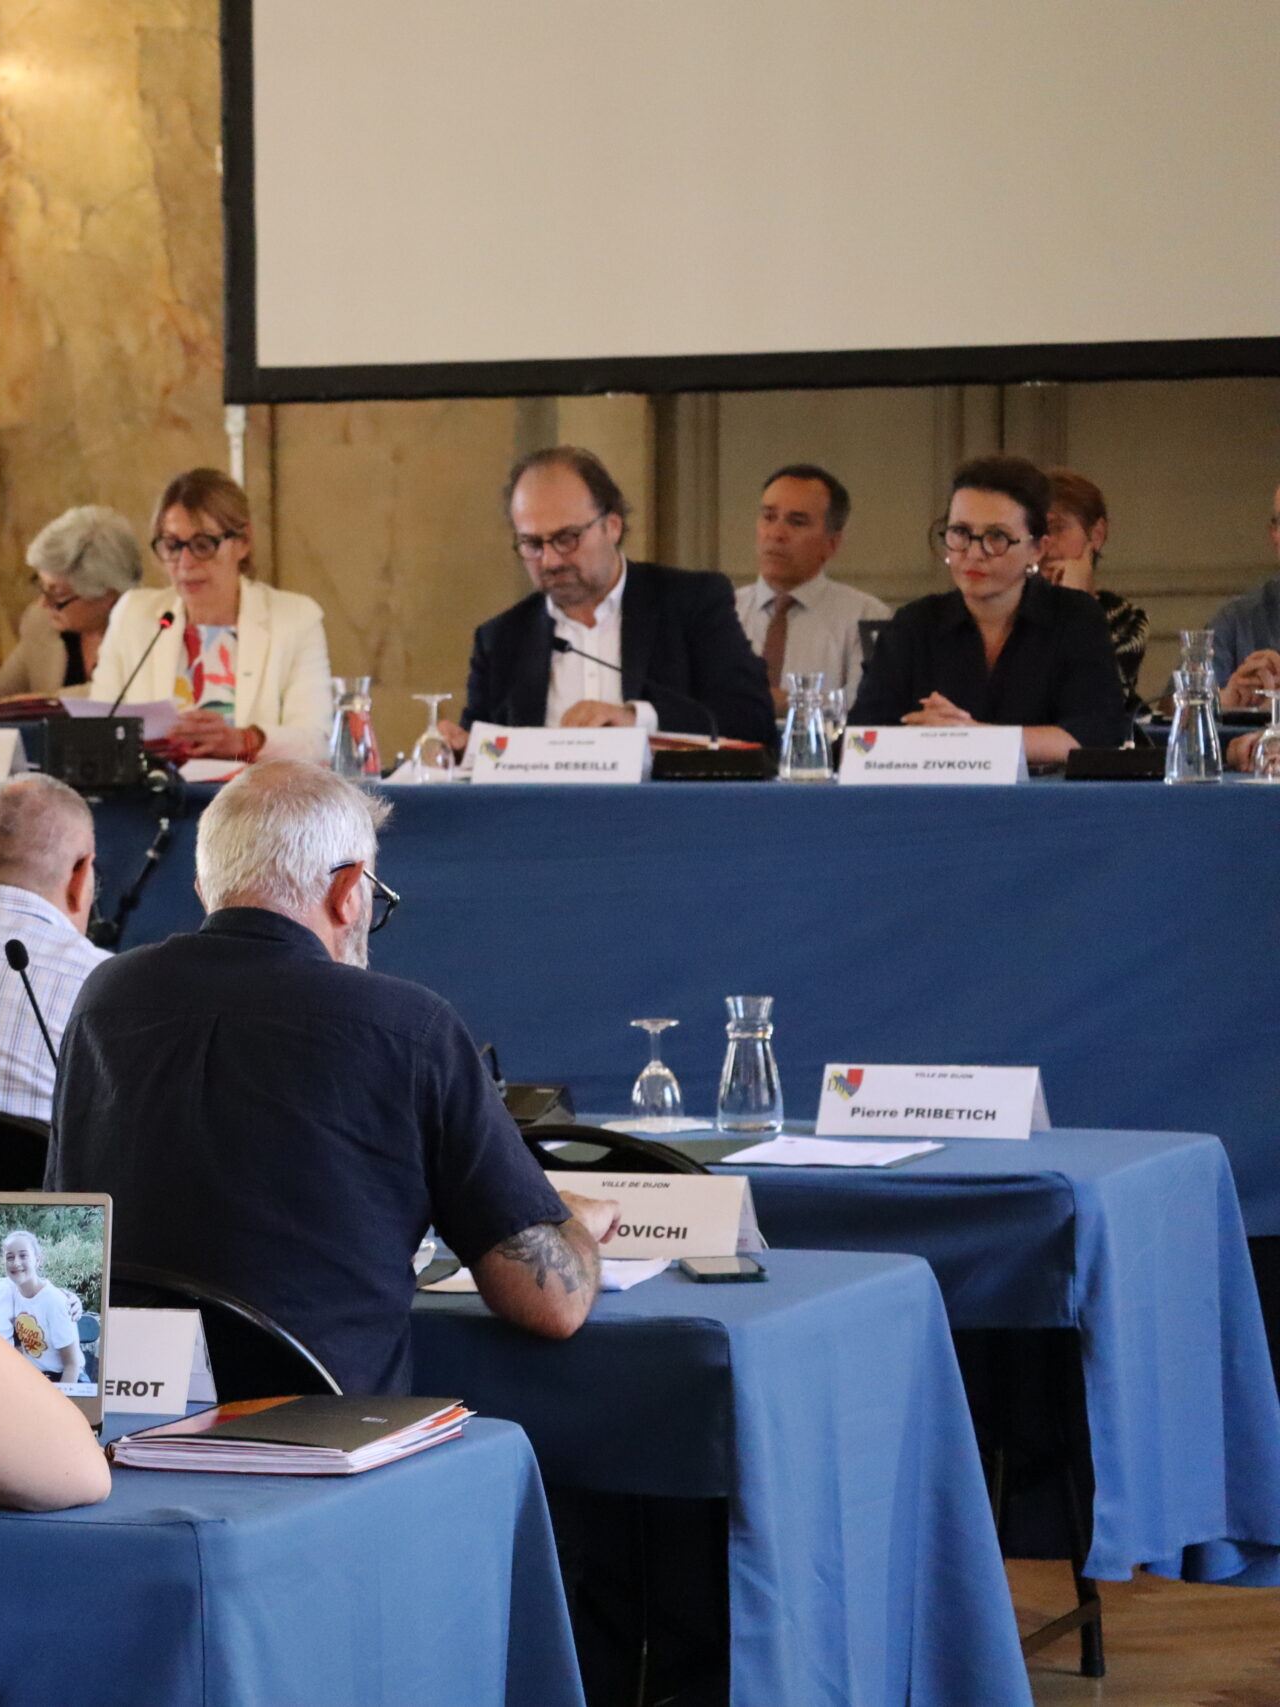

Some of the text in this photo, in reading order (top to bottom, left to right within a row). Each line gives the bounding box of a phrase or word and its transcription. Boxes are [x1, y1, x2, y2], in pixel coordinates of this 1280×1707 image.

[554, 761, 619, 771] DESEILLE
[923, 760, 992, 770] ZIVKOVIC
[850, 1106, 997, 1121] Pierre PRIBETICH
[617, 1224, 688, 1240] OVICHI
[104, 1380, 165, 1398] EROT
